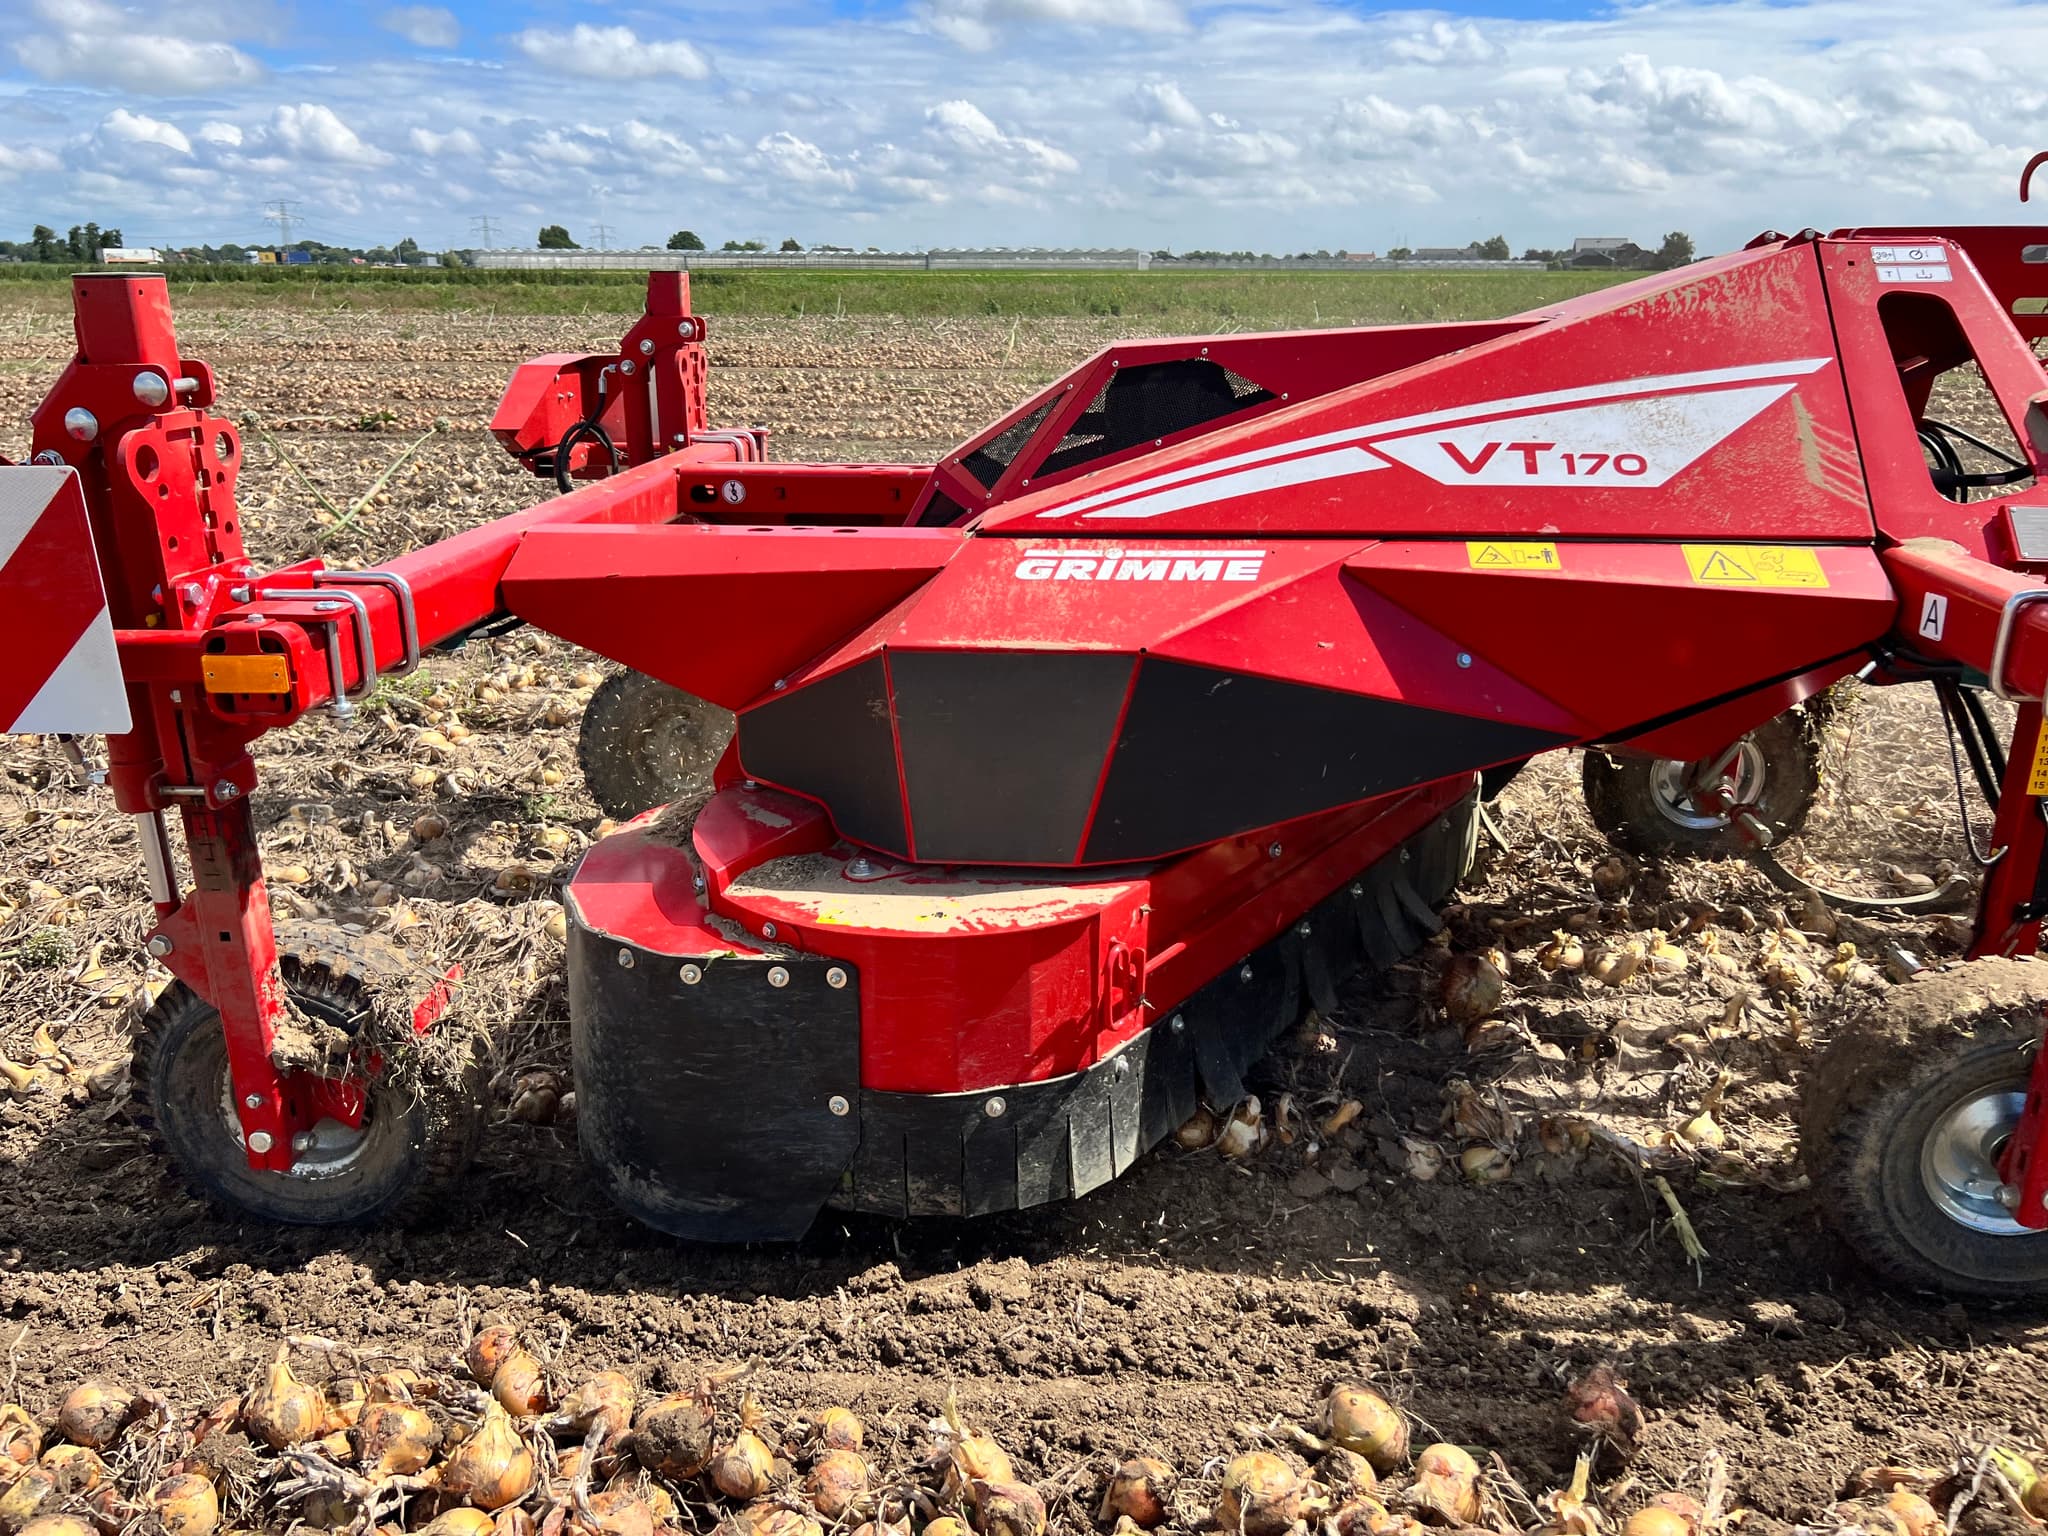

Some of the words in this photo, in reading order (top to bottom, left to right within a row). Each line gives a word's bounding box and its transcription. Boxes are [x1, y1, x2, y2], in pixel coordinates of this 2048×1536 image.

[1438, 442, 1557, 475] VT
[1560, 453, 1648, 476] 170
[1015, 557, 1264, 581] GRIMME
[1922, 599, 1938, 635] A
[2034, 781, 2045, 789] 15
